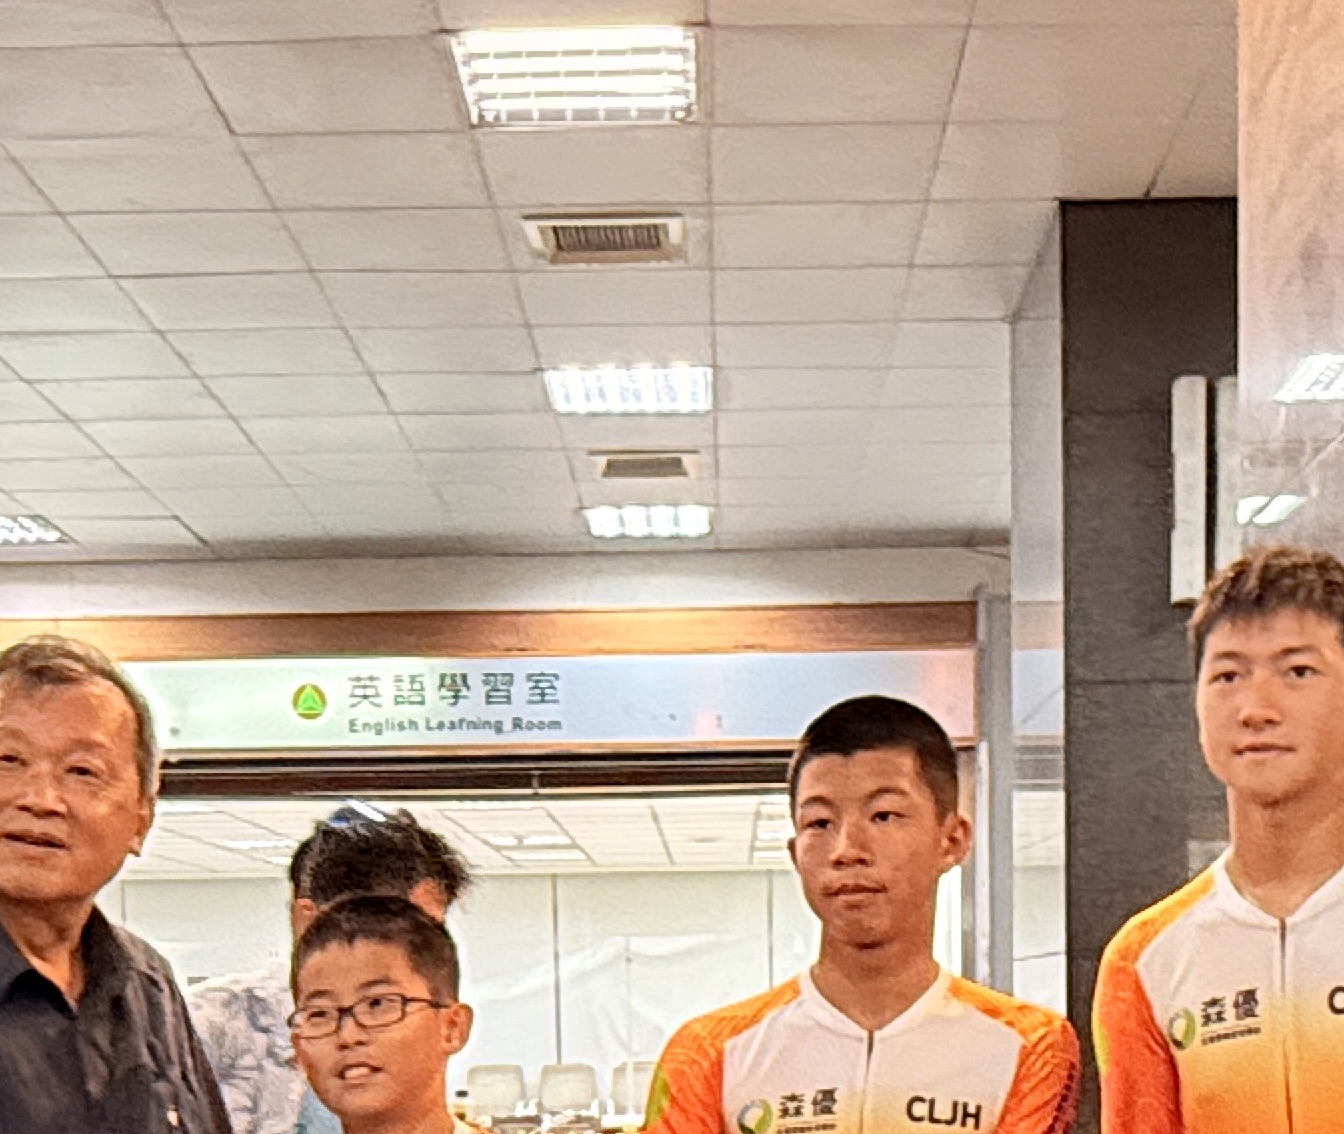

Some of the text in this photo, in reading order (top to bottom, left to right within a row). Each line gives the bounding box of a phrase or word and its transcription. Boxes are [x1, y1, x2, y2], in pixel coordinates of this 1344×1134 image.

[347, 671, 561, 708] 英語學習室
[348, 715, 563, 736] English Learning Room
[905, 1095, 983, 1131] CLJH
